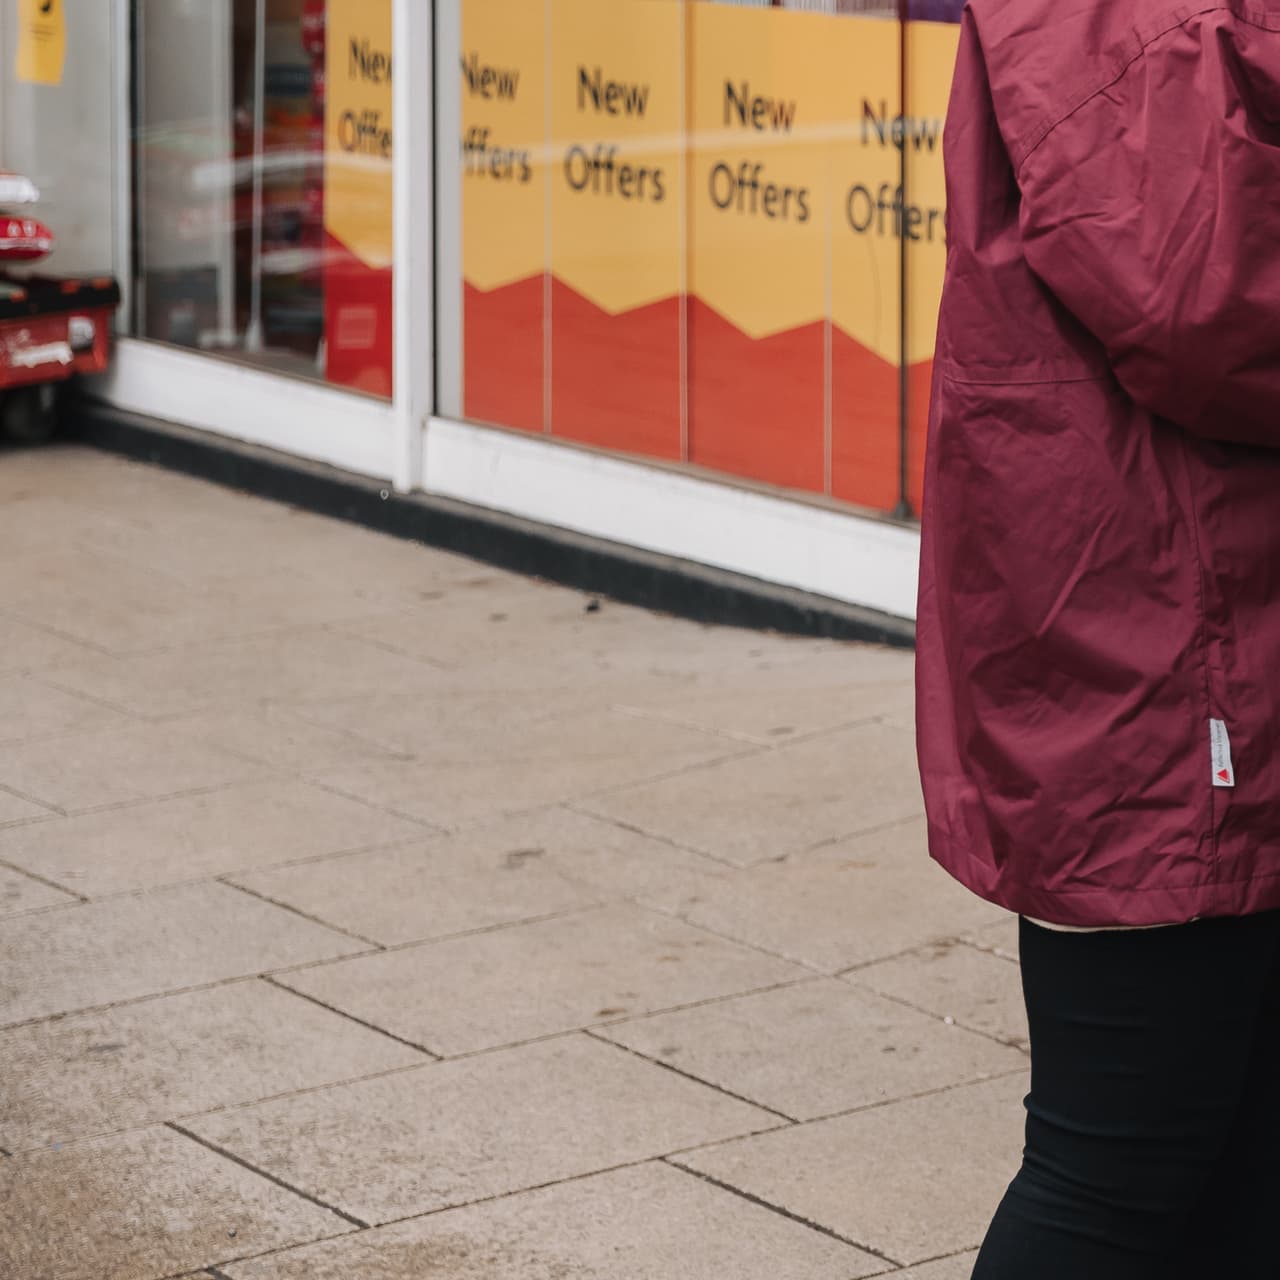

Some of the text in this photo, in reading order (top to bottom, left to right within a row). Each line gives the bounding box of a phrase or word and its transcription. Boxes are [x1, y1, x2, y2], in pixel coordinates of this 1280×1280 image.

[576, 67, 649, 116] New
[723, 80, 797, 132] New
[337, 108, 392, 157] Offe
[860, 96, 938, 151] New
[461, 127, 531, 182] ffers
[564, 144, 665, 202] Offers
[709, 160, 809, 224] Offers
[848, 181, 946, 242] Offer
